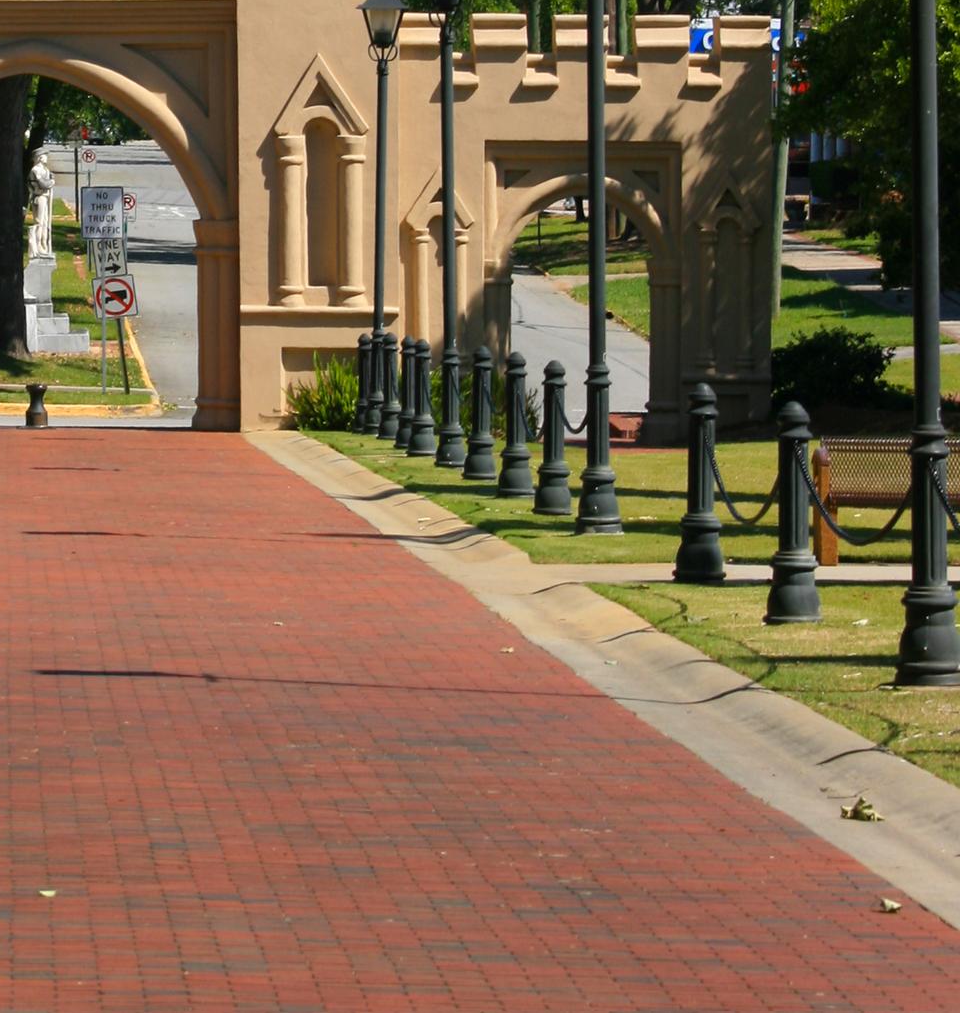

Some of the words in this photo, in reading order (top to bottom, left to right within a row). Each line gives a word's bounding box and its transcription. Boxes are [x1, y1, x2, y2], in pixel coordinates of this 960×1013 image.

[96, 192, 108, 200] NO
[91, 203, 114, 211] THRU
[88, 215, 117, 223] TRUCK
[85, 226, 121, 234] TRAFFIC
[97, 239, 119, 251] ONE
